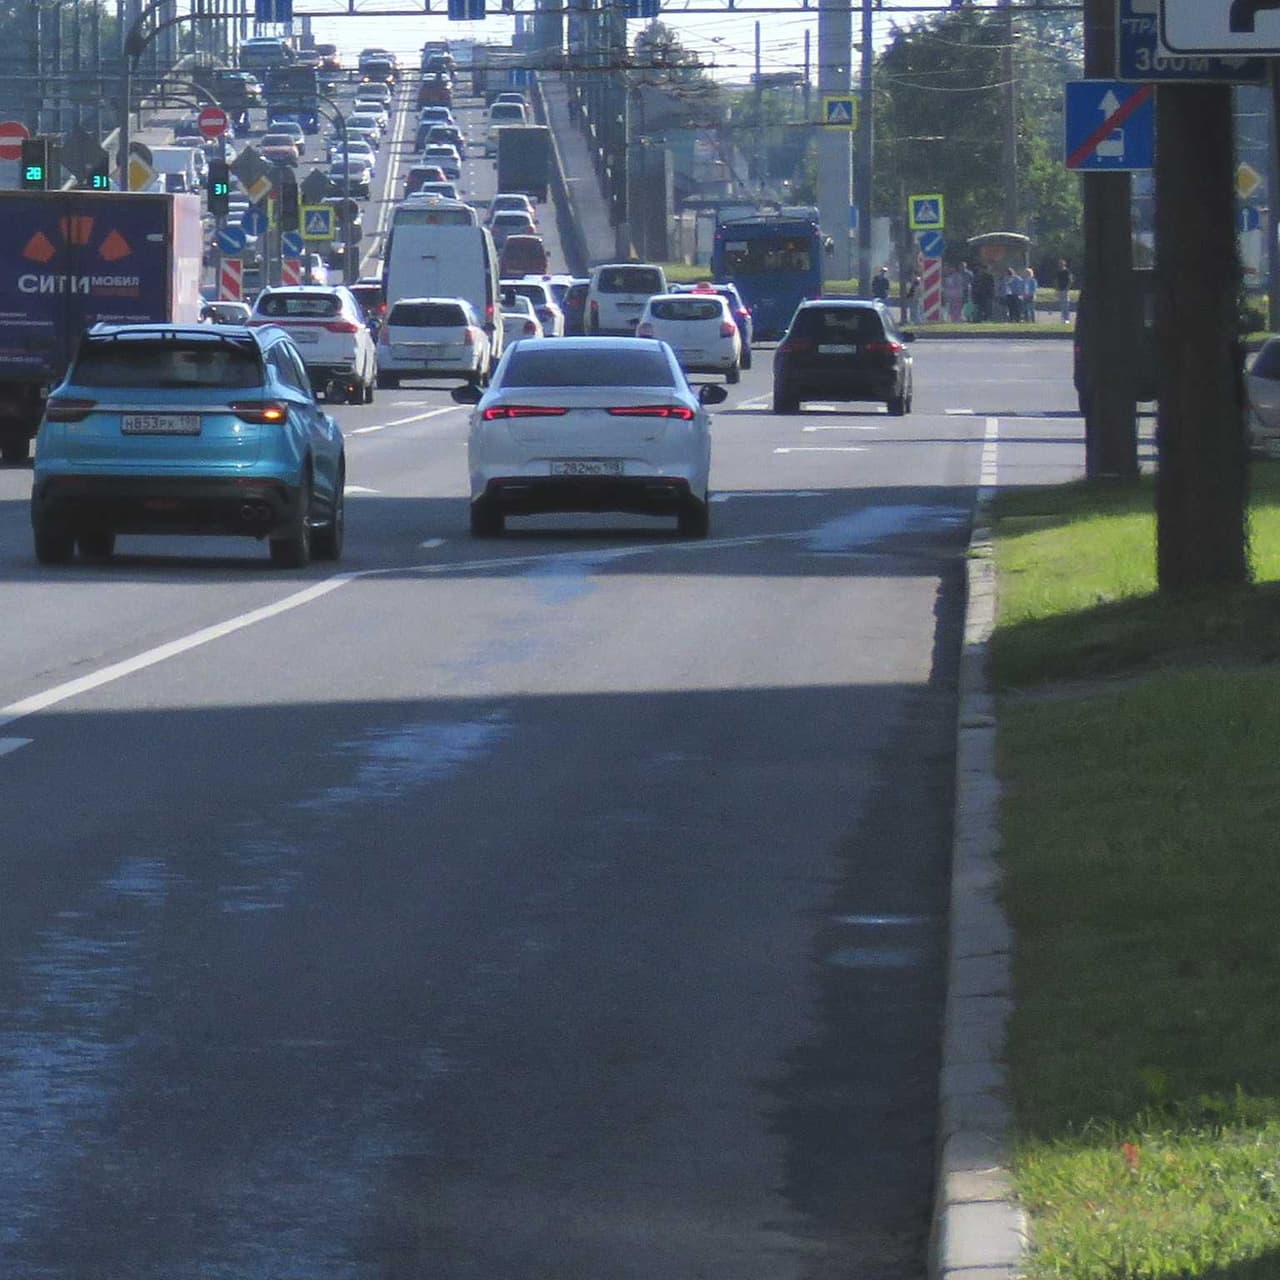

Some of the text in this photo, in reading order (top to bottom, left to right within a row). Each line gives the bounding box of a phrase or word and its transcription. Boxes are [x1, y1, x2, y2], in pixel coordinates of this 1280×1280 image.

[26, 167, 42, 181] 28
[93, 175, 107, 187] 31
[215, 183, 228, 195] 31
